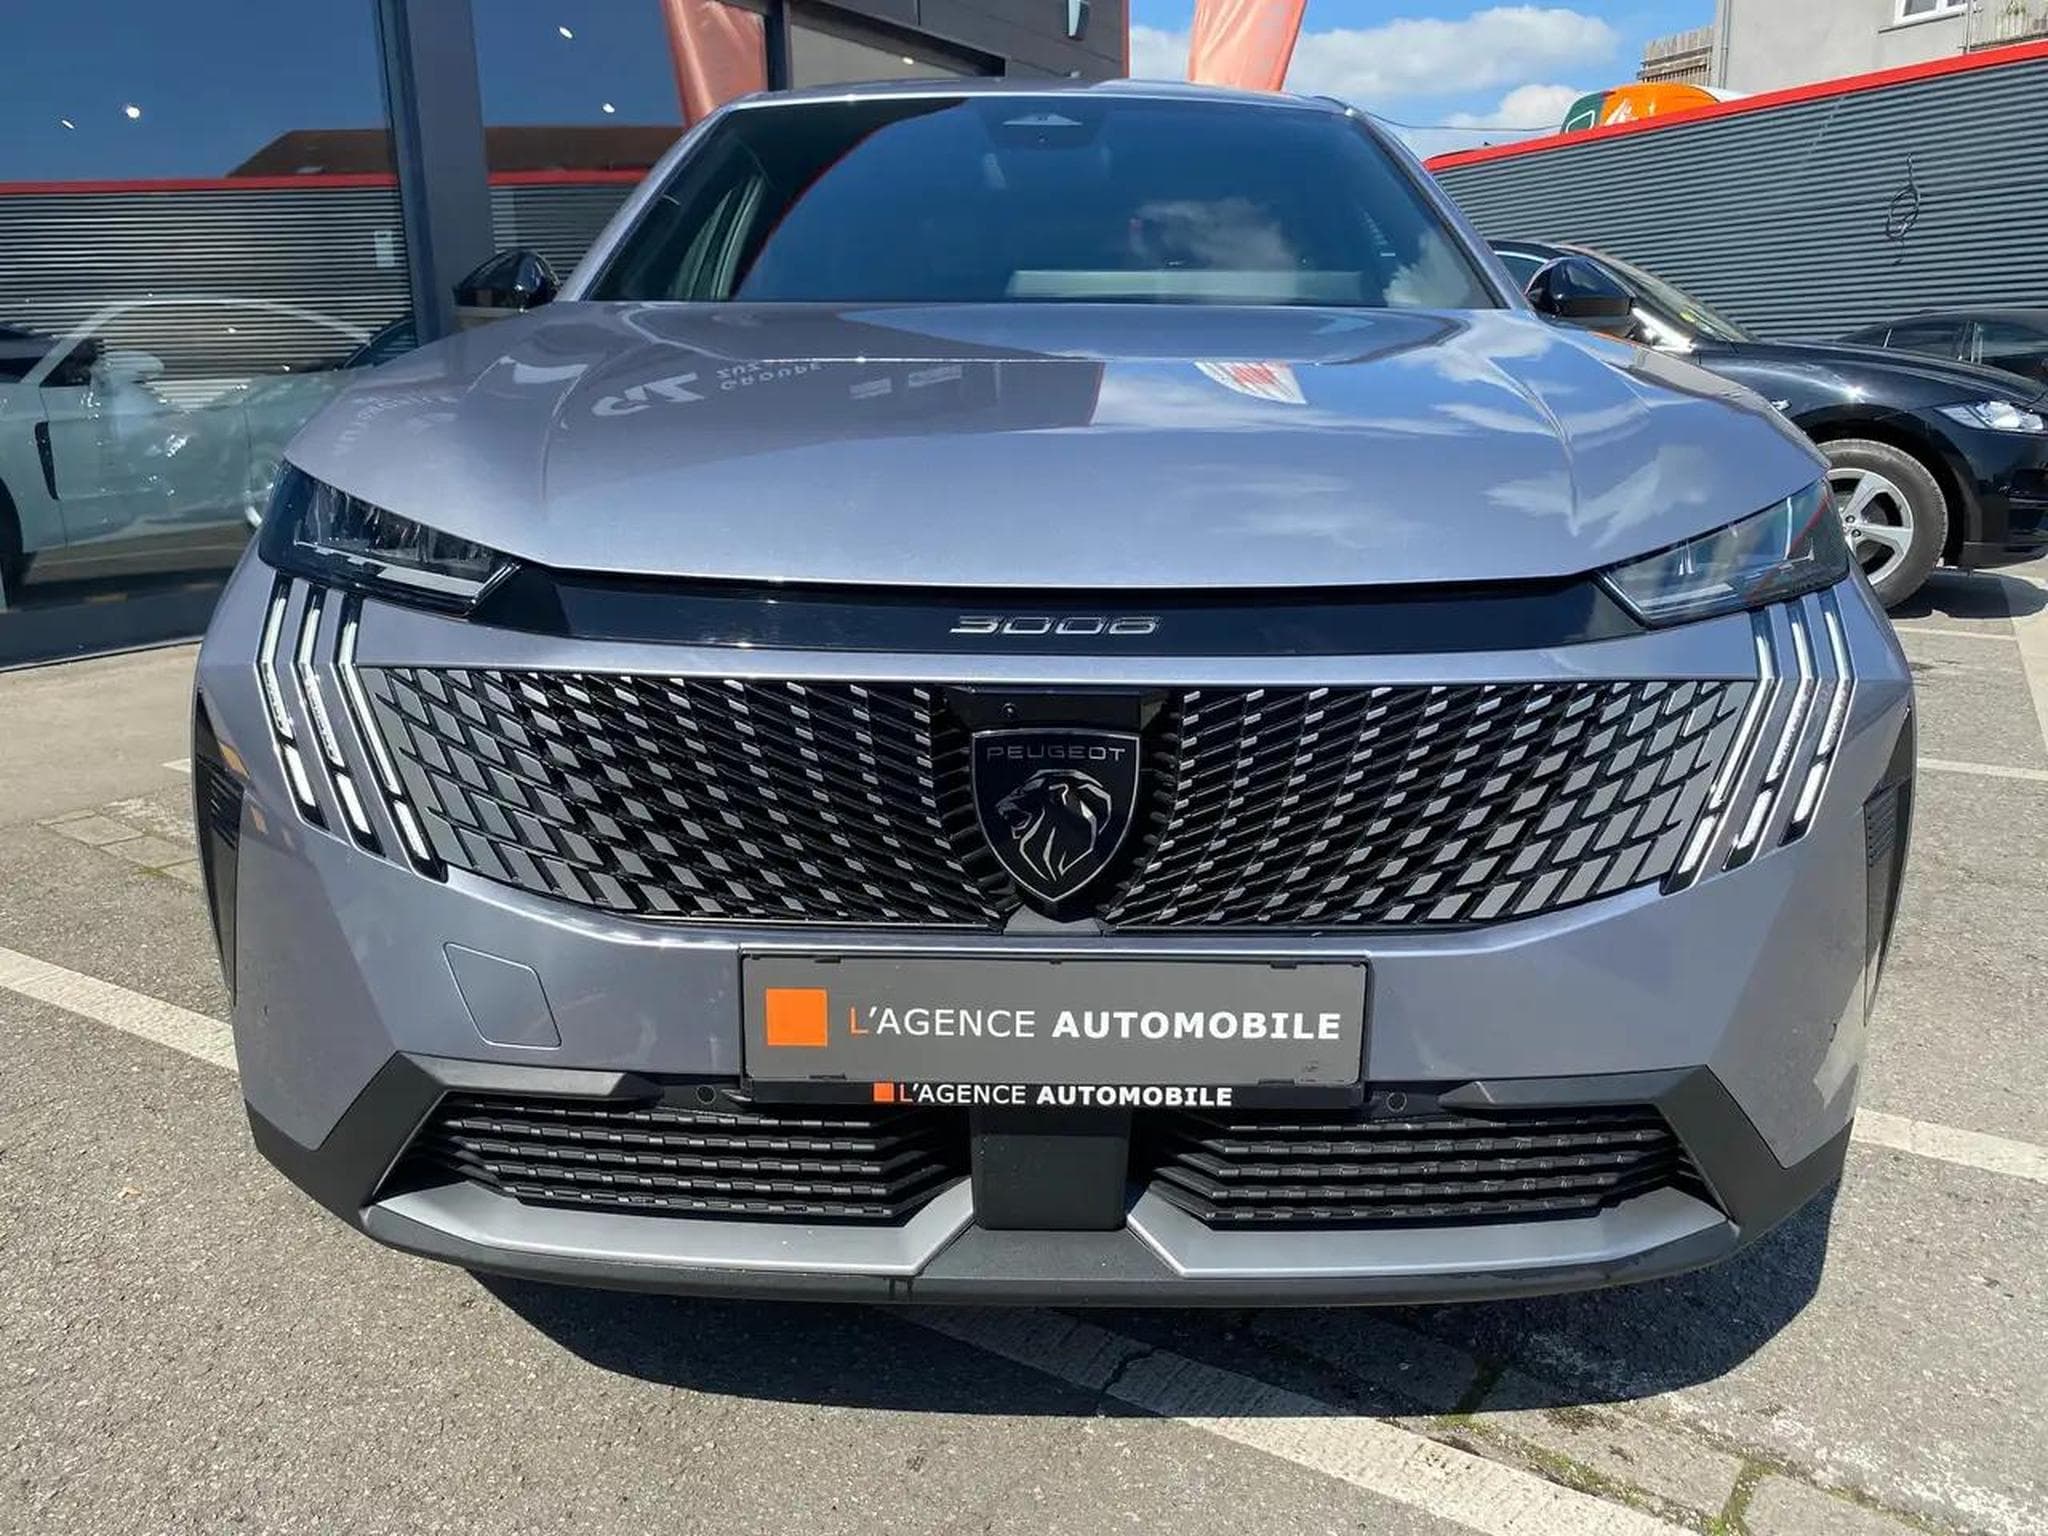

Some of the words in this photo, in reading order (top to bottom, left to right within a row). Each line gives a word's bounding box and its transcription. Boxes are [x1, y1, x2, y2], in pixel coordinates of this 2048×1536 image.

[950, 615, 1161, 635] 3008
[986, 745, 1126, 762] PEUGEOT
[849, 1007, 1036, 1038] L'AGENCE
[1051, 1011, 1341, 1040] AUTOMOBILE
[899, 1084, 1027, 1104] L'AGENCE
[1036, 1085, 1233, 1107] AUTOMOBILE
